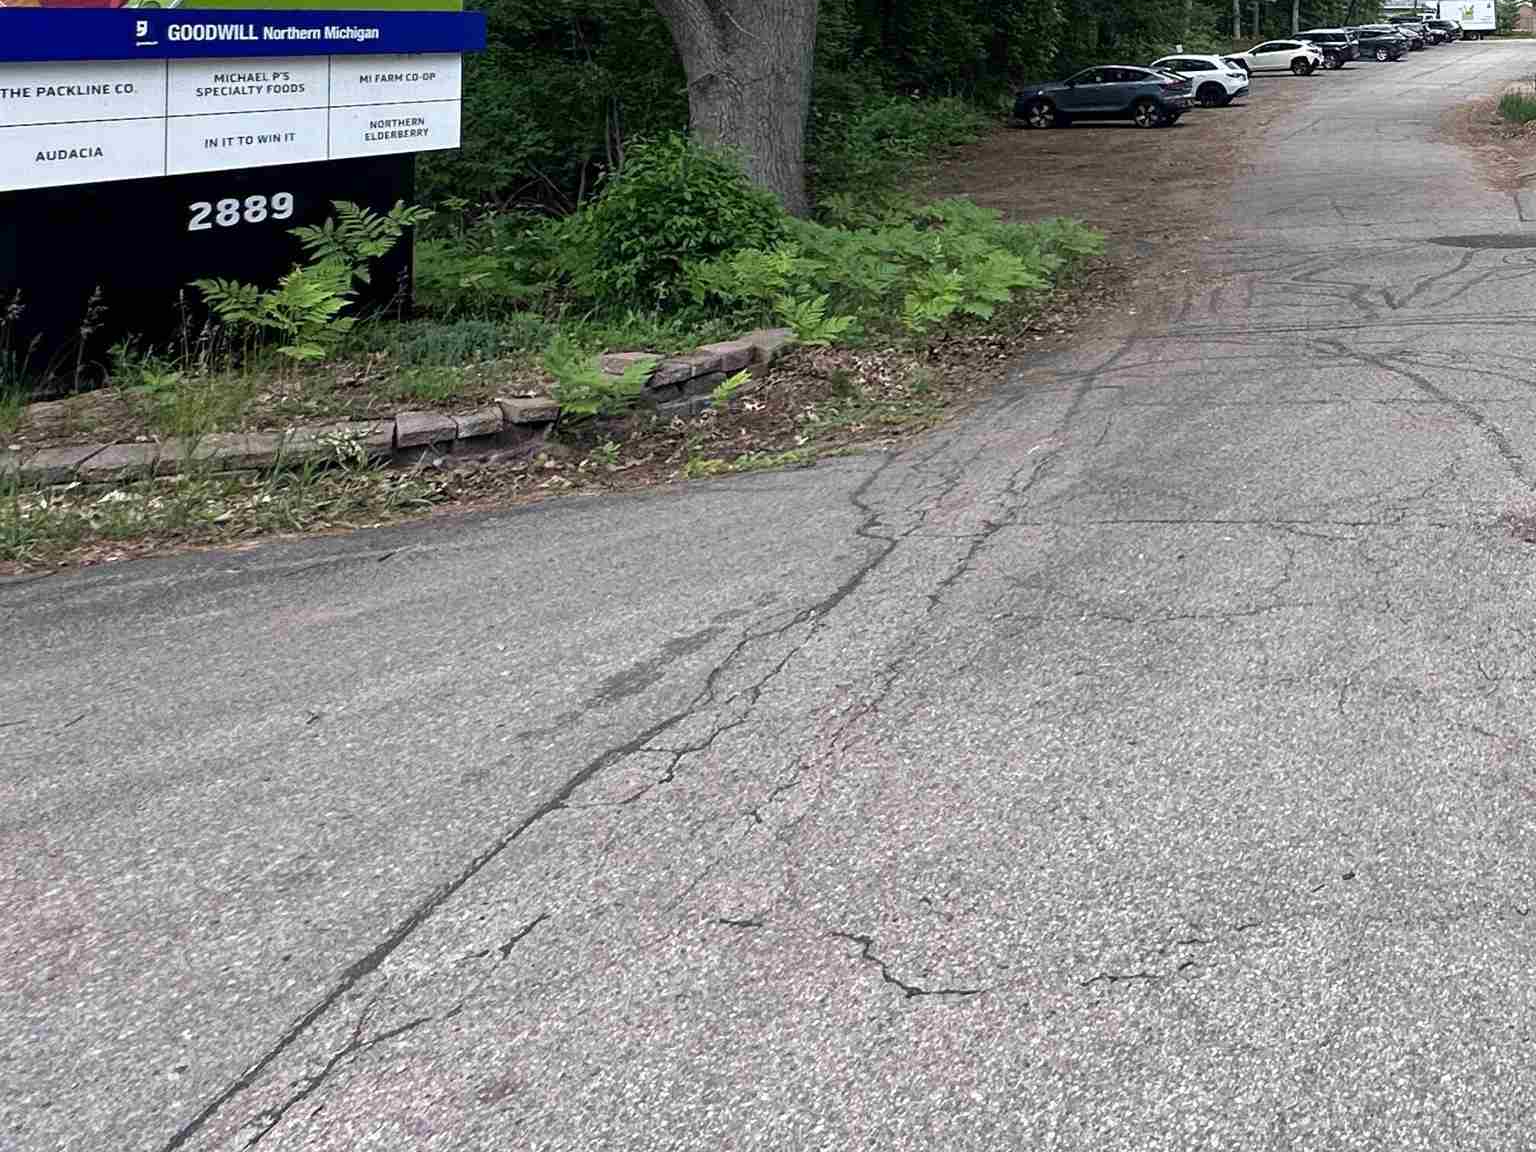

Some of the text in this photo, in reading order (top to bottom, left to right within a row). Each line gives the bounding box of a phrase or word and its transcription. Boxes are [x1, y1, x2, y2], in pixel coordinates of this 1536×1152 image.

[168, 24, 380, 42] GOODWILL Northern Michigan
[213, 71, 290, 84] MICHAEL P'S
[359, 72, 436, 84] MI FARM CO-OP
[1, 87, 31, 99] THE
[36, 84, 110, 97] PACKLINE
[196, 83, 305, 97] SPECIALTY FOODS
[369, 117, 425, 129] NORTHERN
[204, 132, 296, 149] IN IT TO WIN IT
[364, 128, 429, 141] ELDERBERRY
[35, 147, 103, 162] AUDACIA
[188, 192, 294, 232] 2889
